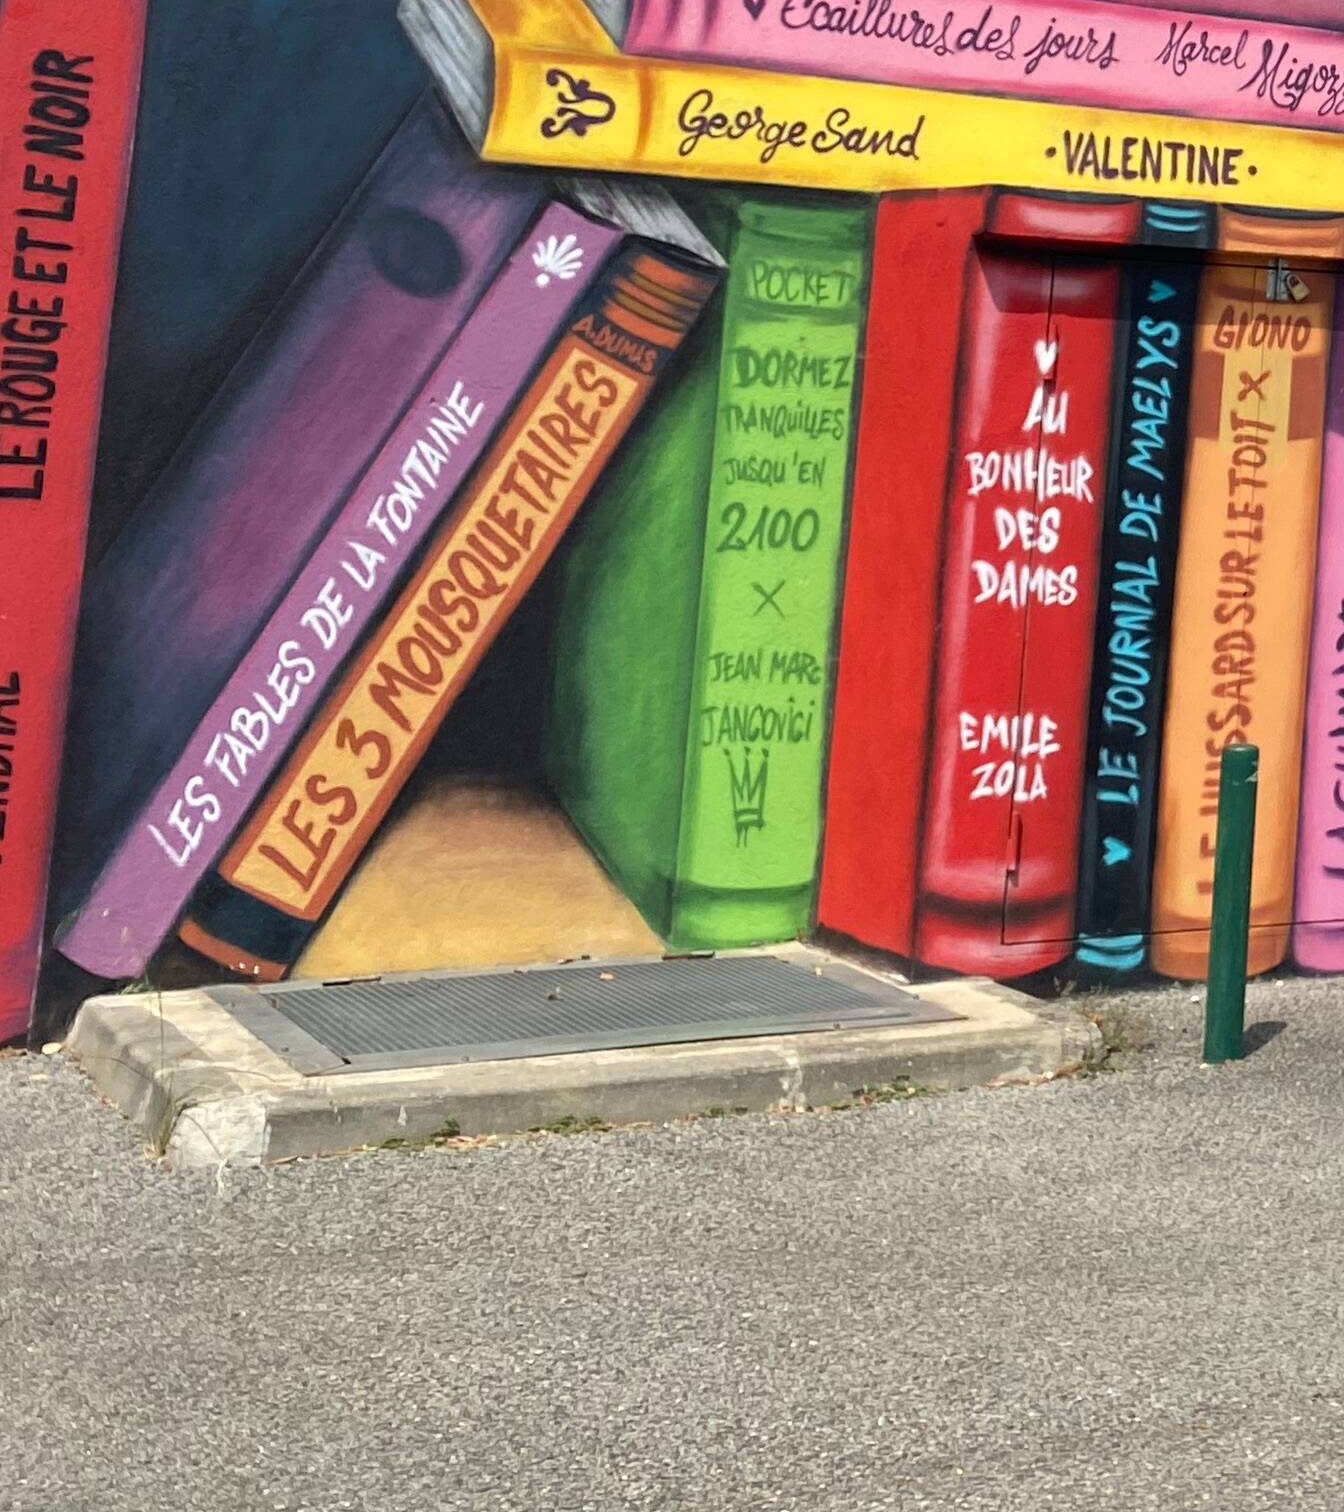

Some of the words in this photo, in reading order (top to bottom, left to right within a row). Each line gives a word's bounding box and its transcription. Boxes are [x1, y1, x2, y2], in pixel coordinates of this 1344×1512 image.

[1154, 20, 1248, 78] Marcel
[23, 48, 96, 162] NOIR
[678, 88, 806, 165] George
[811, 107, 923, 162] Sand
[14, 163, 79, 223] LE
[13, 225, 75, 285] ET
[751, 259, 855, 304] POCKET
[1213, 304, 1313, 353] GIONO
[0, 289, 69, 429] ROUGE
[733, 345, 853, 389] DORMEZ
[1021, 387, 1069, 435] AU
[1126, 314, 1182, 482] MAELYS
[964, 449, 1094, 505] BONHEUR
[1227, 409, 1277, 497] TOIT
[715, 502, 820, 554] 2100
[994, 506, 1060, 554] DES
[1118, 488, 1163, 543] DE
[1223, 501, 1265, 543] LE
[972, 560, 1079, 609] DAMES
[147, 775, 222, 868] LES
[203, 639, 316, 788] FABLES
[300, 577, 355, 650] DE
[340, 540, 386, 592] LA
[365, 380, 485, 547] FONTAINE
[257, 773, 358, 893] LES
[335, 717, 392, 781] 3
[368, 359, 619, 734] MOUSQUETAIRES
[1101, 555, 1161, 738] JOURNAL
[708, 649, 764, 686] JEAN
[700, 696, 817, 748] JANCOVICI
[958, 711, 1061, 756] EMILE
[969, 758, 1048, 801] ZOLA
[1096, 747, 1141, 806] LE
